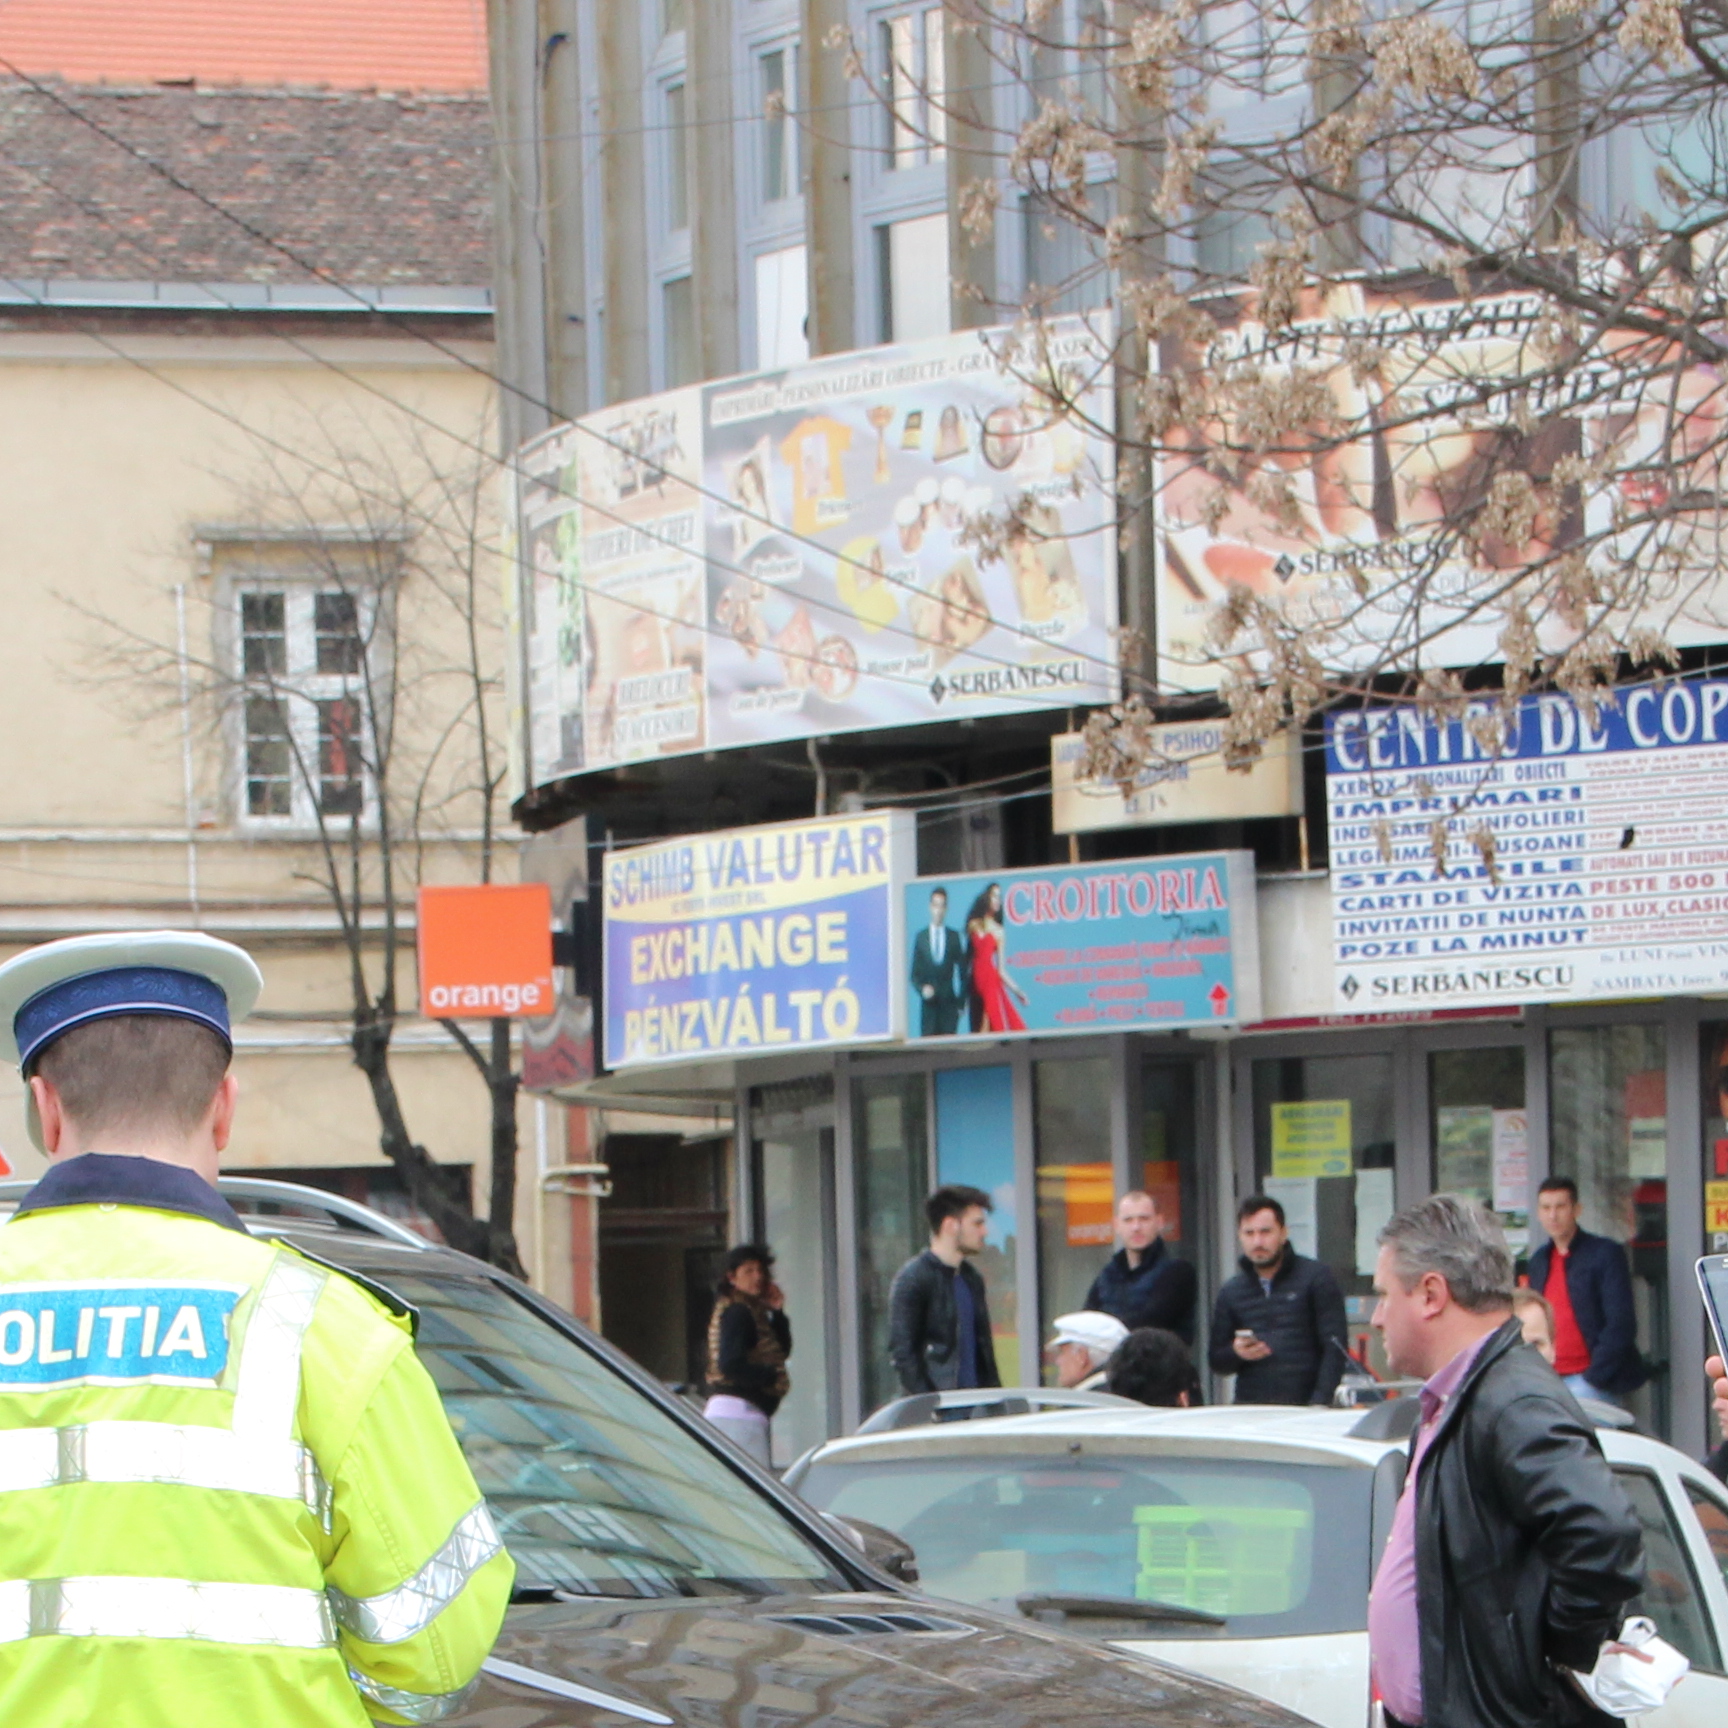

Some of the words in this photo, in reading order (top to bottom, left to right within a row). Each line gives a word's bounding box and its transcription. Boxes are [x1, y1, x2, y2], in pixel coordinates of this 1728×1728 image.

[1515, 761, 1566, 781] OBIECTE
[1335, 786, 1583, 819] IMPRIMARI
[610, 846, 695, 909] SCHIMB
[706, 825, 887, 889] VALUTAR
[1005, 866, 1227, 925] CROITORIA
[1339, 892, 1423, 912] CARTI
[1433, 889, 1470, 906] DE
[1480, 881, 1584, 903] VIZITA
[1590, 875, 1658, 895] PESTE
[1669, 873, 1715, 891] 500
[1339, 914, 1449, 937] INVITATII
[1459, 910, 1488, 928] DE
[1499, 905, 1586, 925] NUNTA
[1591, 903, 1615, 920] DE
[631, 911, 849, 985] EXCHANGE
[1339, 939, 1420, 960] POZE
[1432, 936, 1469, 951] LA
[1480, 928, 1590, 950] MINUT
[1619, 947, 1661, 963] LUNI
[429, 982, 540, 1013] orange
[1372, 965, 1574, 998] SERBANESCU
[624, 975, 861, 1057] PÉNZVÁLTÓ
